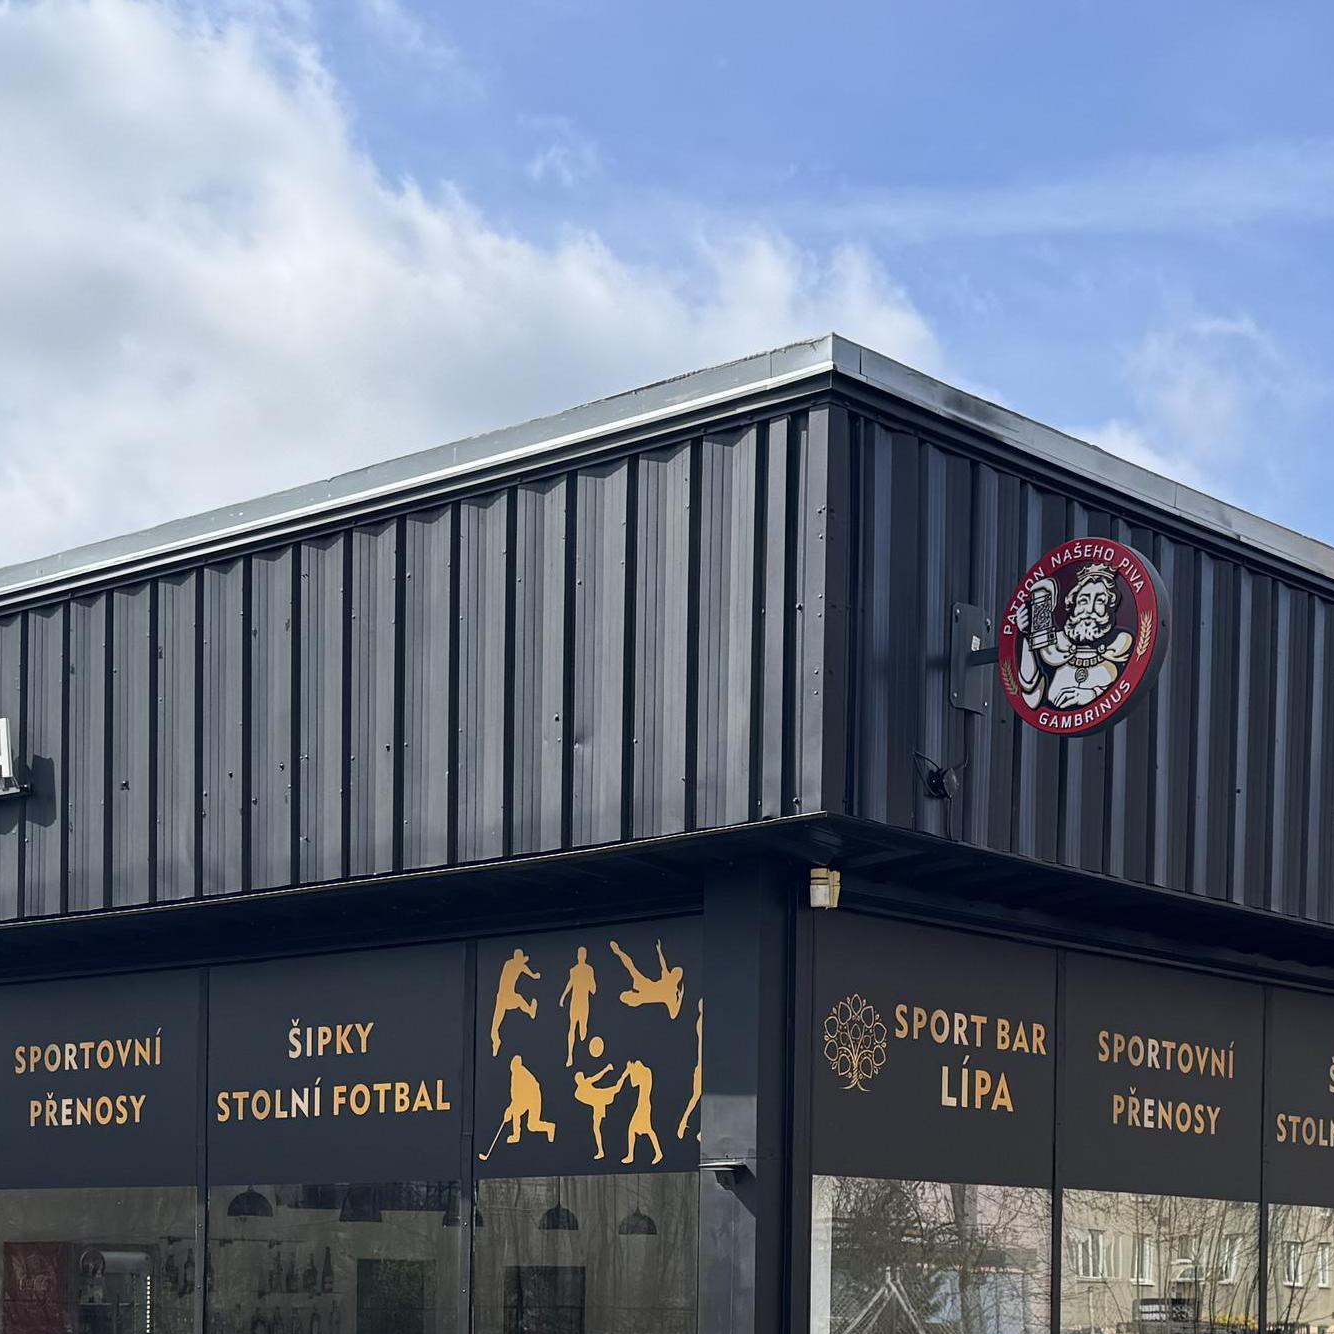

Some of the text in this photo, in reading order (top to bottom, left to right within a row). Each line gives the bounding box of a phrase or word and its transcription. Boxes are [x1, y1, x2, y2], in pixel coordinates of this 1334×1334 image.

[1003, 542, 1146, 635] PATRON NAŠEHO PIVA
[1038, 679, 1131, 729] GAMBRINUS
[14, 1027, 162, 1074] SPORTOVNÍ
[288, 1018, 374, 1059] ŠIPKY
[894, 1004, 1047, 1056] SPORT BAR
[1097, 1030, 1235, 1079] SPORTOVNÍ
[217, 1077, 451, 1122] STOLNÍ FOTBAL
[940, 1054, 1014, 1112] LÍPA
[30, 1092, 146, 1127] PŘENOSY
[1112, 1088, 1221, 1135] PŘENOSY
